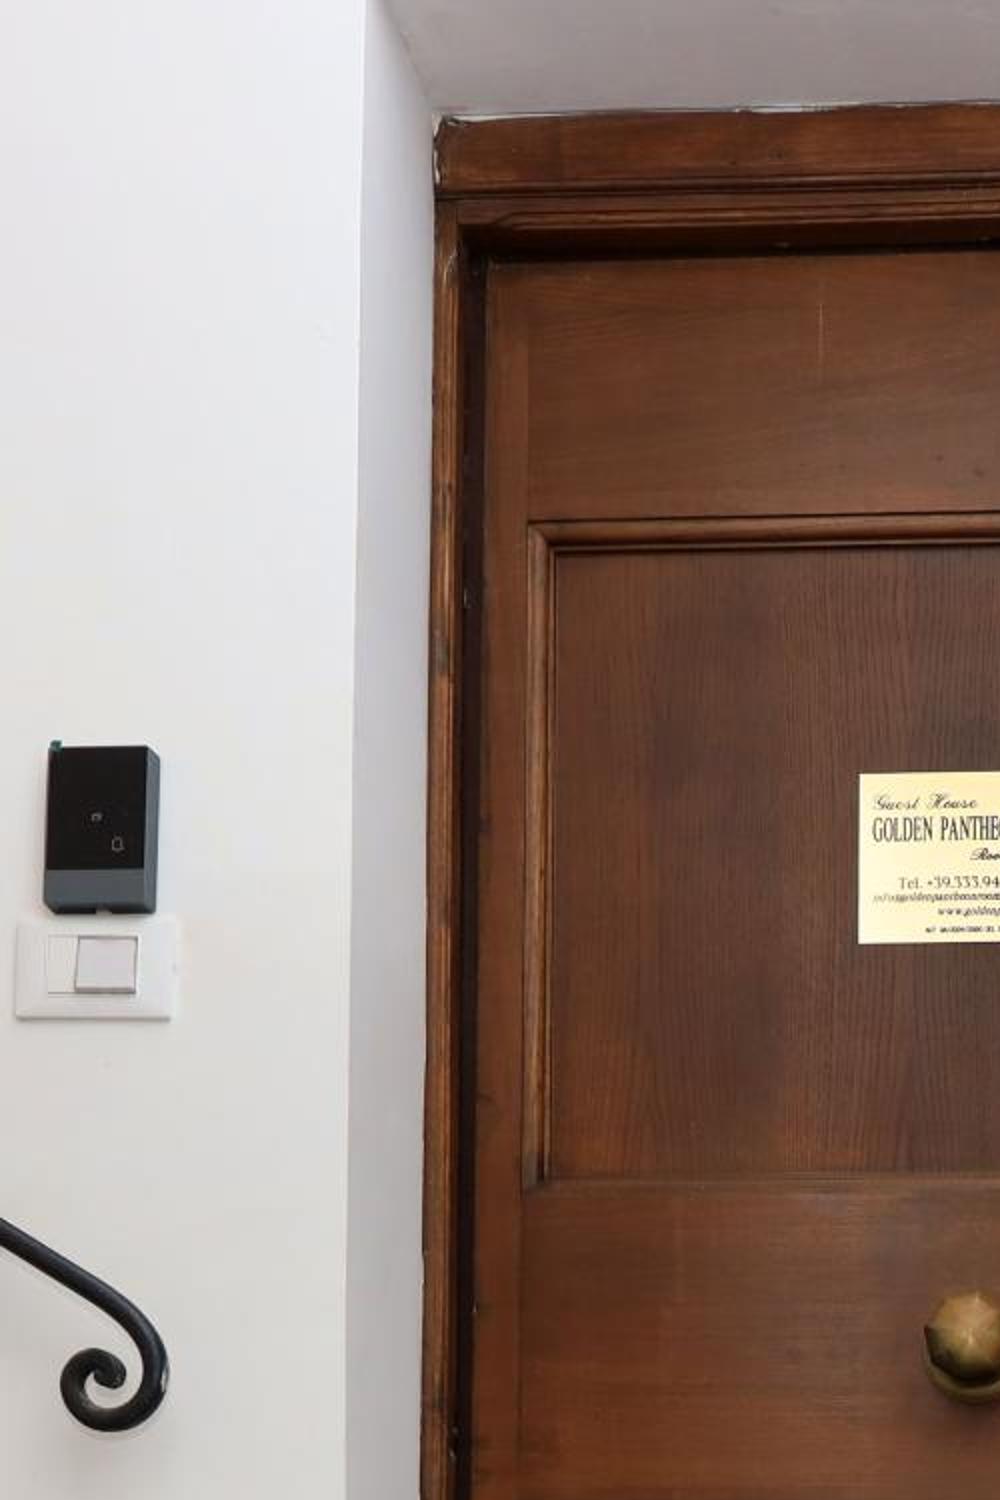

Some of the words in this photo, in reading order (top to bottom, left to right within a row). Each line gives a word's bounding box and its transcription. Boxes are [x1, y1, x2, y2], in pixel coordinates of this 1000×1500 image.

[873, 796, 919, 810] Guest
[929, 793, 977, 809] House
[872, 816, 933, 842] GOLDEN
[899, 876, 923, 889] Tel.
